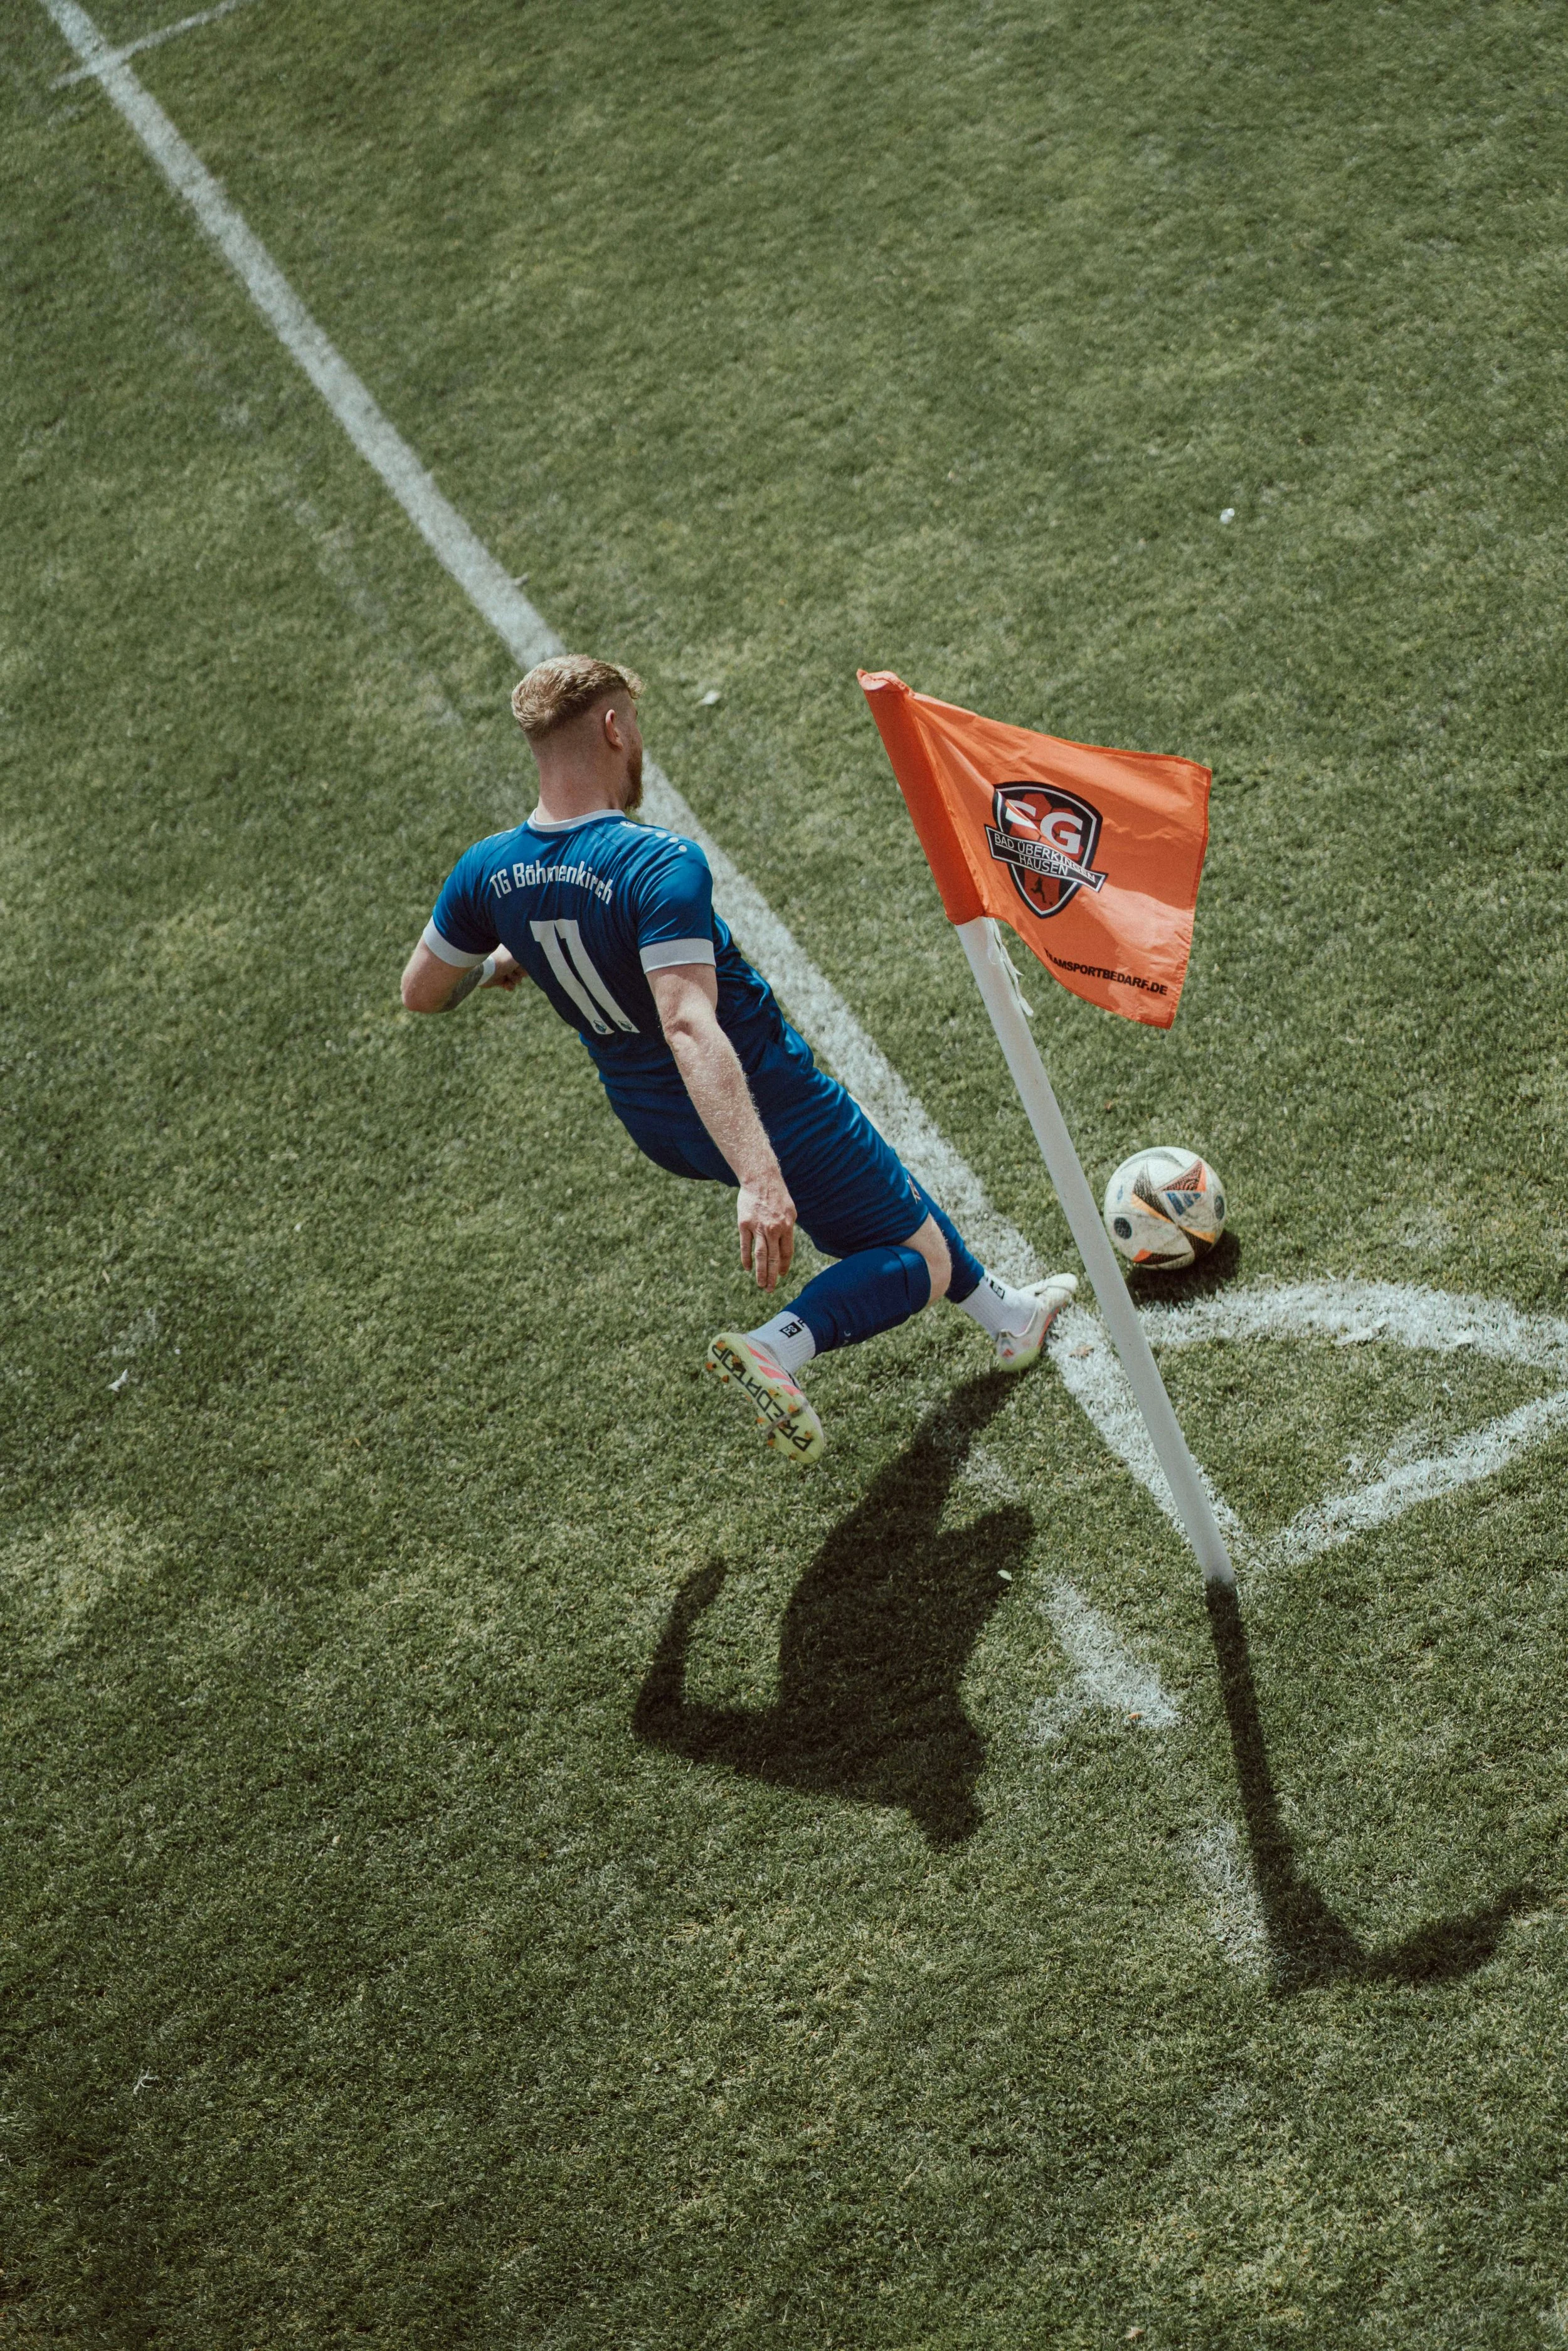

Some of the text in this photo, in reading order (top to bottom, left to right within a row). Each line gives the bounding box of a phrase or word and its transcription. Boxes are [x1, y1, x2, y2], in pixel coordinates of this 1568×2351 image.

[489, 859, 613, 905] TG Böhmenkirch
[994, 833, 1096, 883] BAD ÜBERKINGEN
[1019, 854, 1068, 876] HAUSEN
[529, 918, 640, 1035] 11
